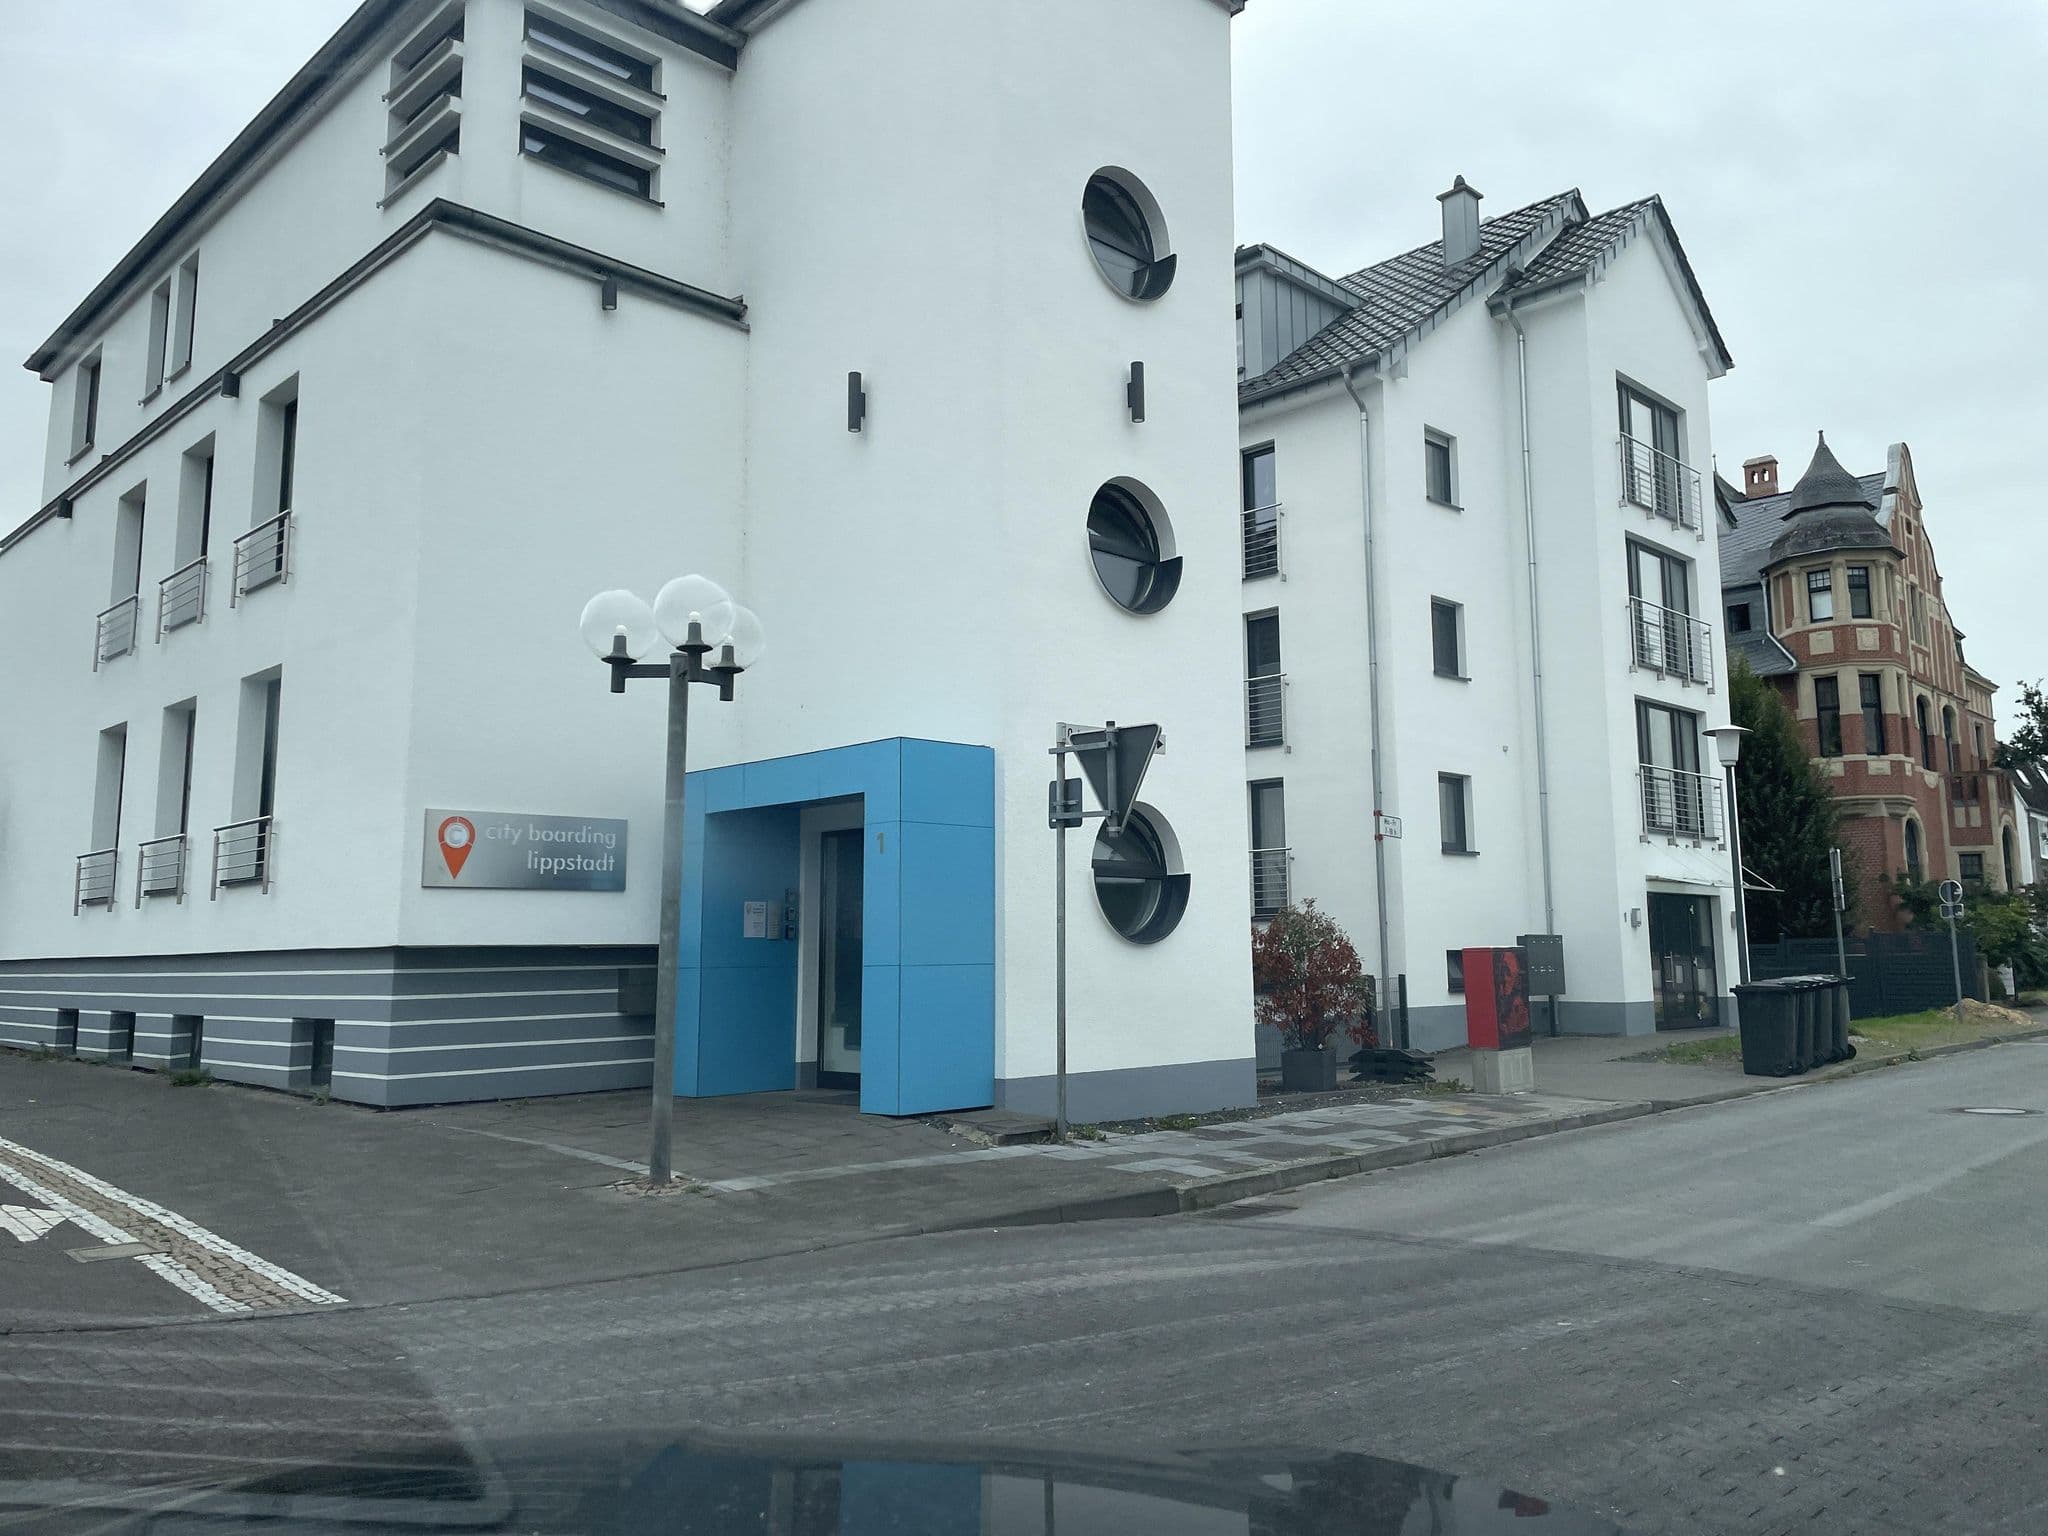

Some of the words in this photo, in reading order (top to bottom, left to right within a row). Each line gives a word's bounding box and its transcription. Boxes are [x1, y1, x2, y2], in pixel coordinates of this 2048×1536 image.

[486, 823, 522, 845] city
[528, 823, 617, 849] boarding
[876, 832, 884, 855] 1
[527, 851, 616, 875] lippstadt
